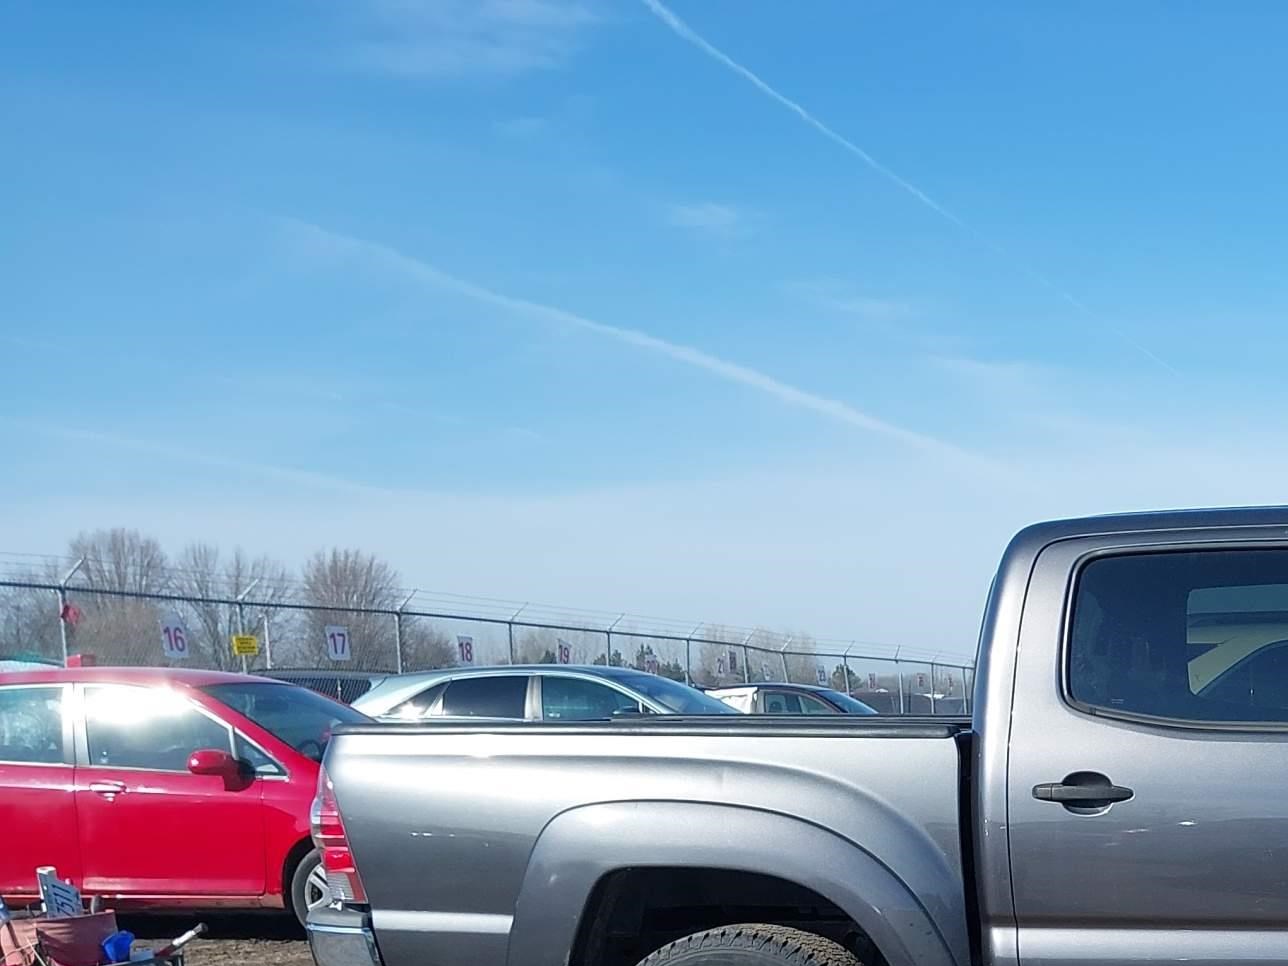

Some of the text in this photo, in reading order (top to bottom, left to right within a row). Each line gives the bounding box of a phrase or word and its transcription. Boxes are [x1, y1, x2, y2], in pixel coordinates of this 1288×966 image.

[163, 626, 186, 652] 16
[329, 632, 347, 654] 17
[459, 641, 473, 662] 18
[559, 644, 570, 664] 19
